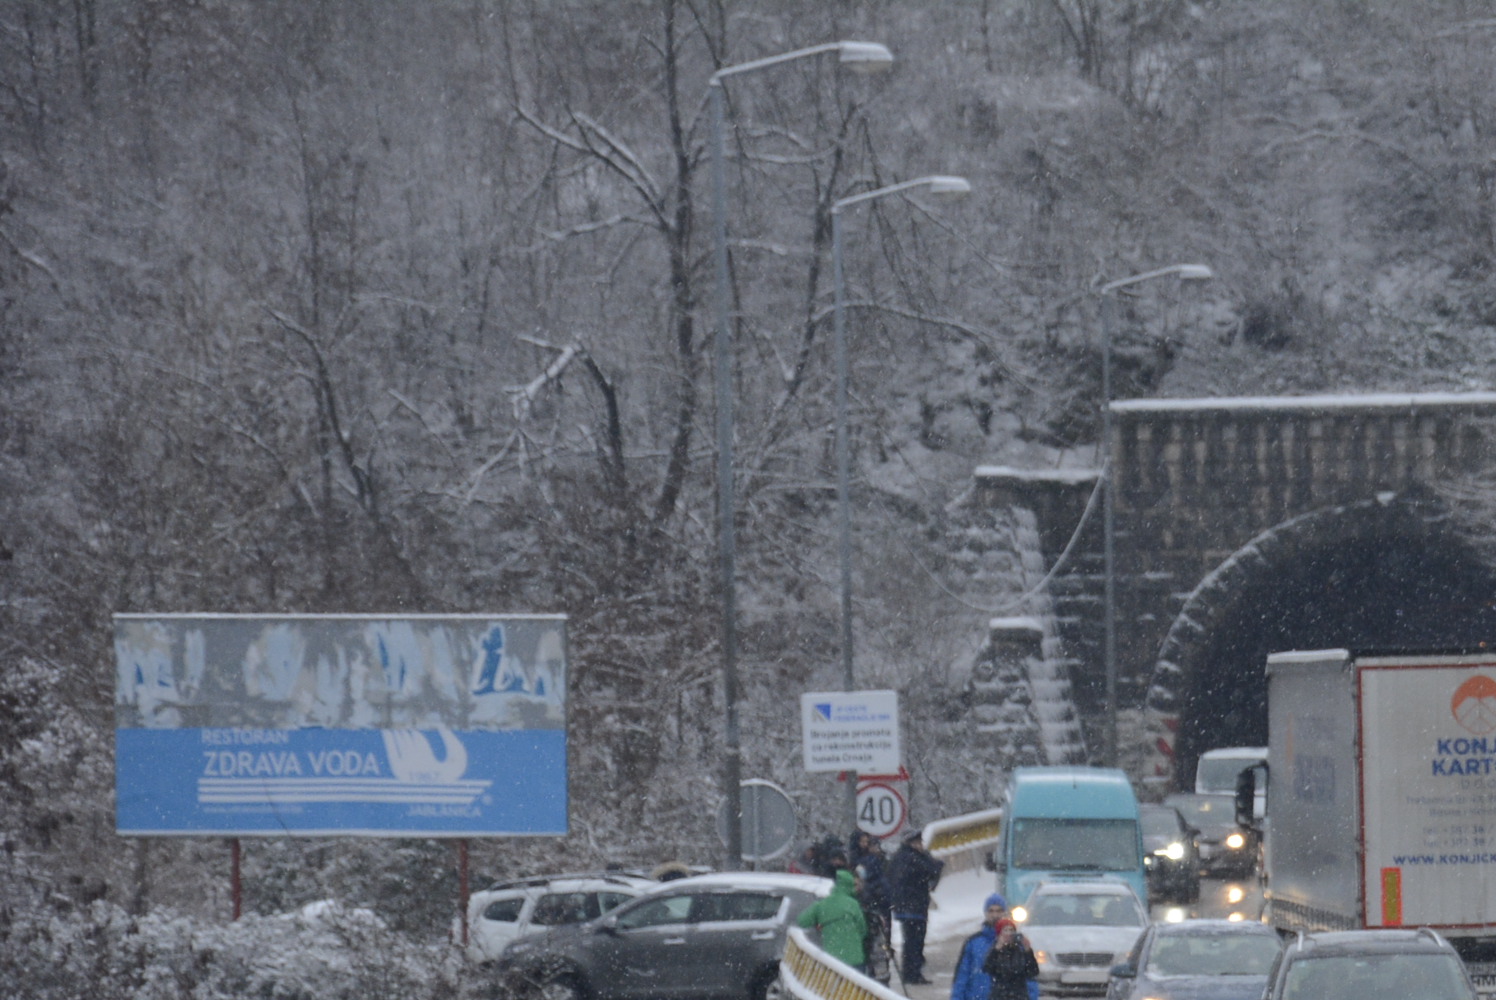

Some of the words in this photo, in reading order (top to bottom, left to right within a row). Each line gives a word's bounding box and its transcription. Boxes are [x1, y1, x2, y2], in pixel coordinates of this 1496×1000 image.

[202, 729, 289, 745] RESTORAN
[204, 751, 303, 776] ZDRAVA
[308, 750, 381, 776] VODA
[860, 796, 895, 825] 40
